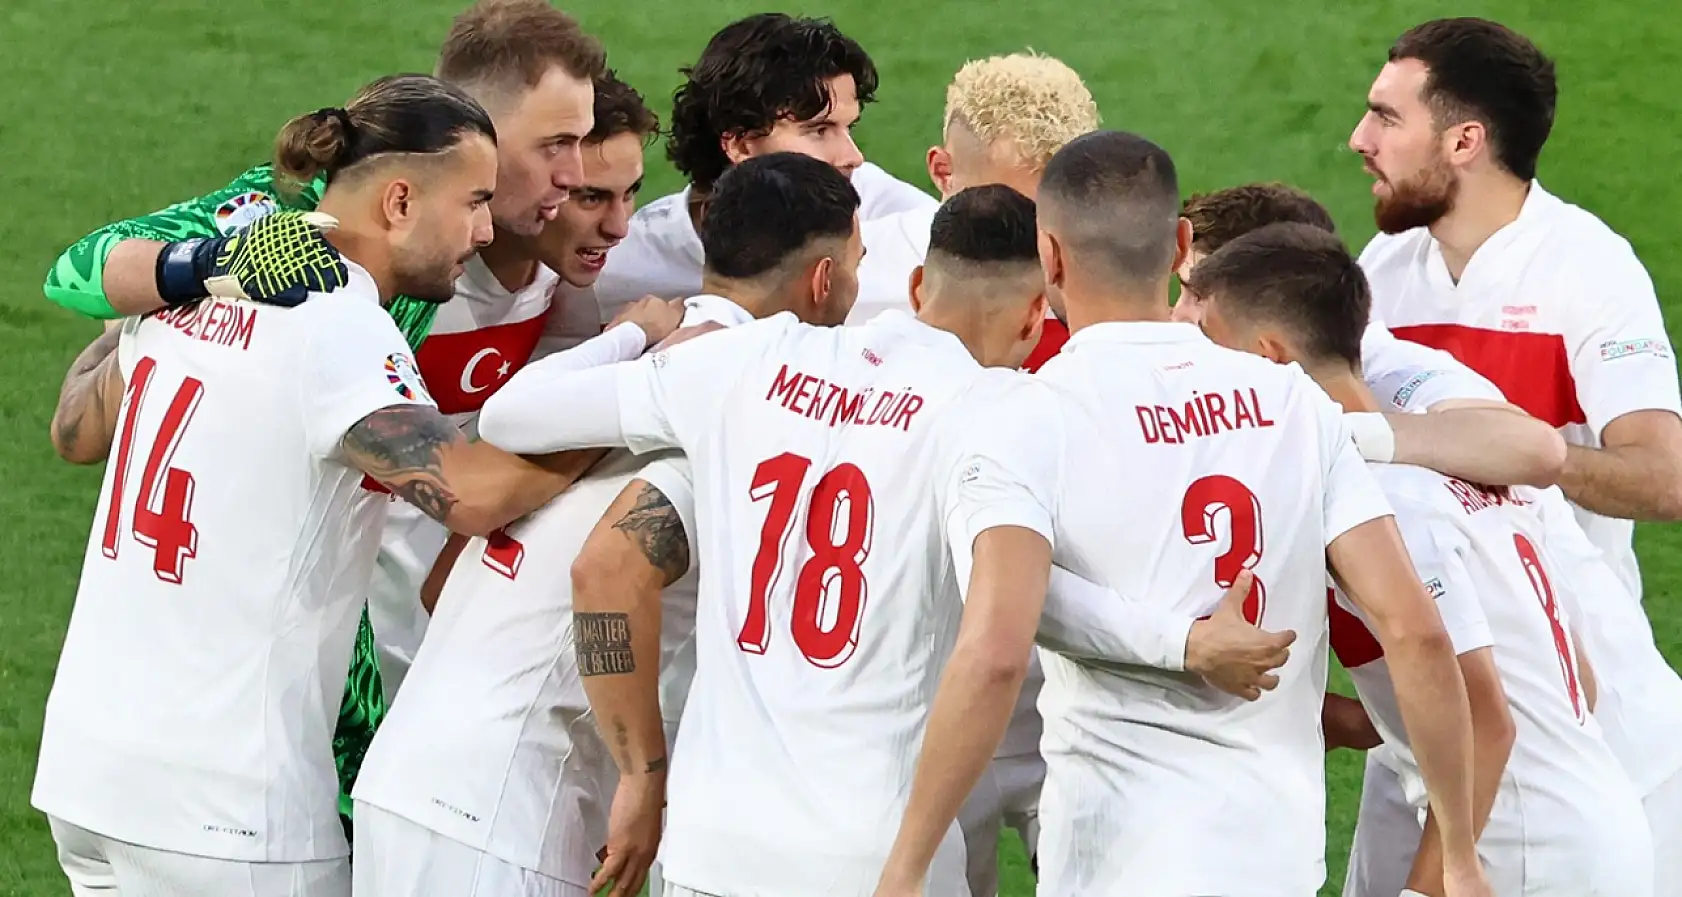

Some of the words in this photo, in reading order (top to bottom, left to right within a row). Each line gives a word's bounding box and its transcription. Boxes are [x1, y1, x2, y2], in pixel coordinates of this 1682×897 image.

[102, 356, 204, 584] 14
[1135, 388, 1274, 444] DEMİRAL
[737, 451, 875, 668] 18
